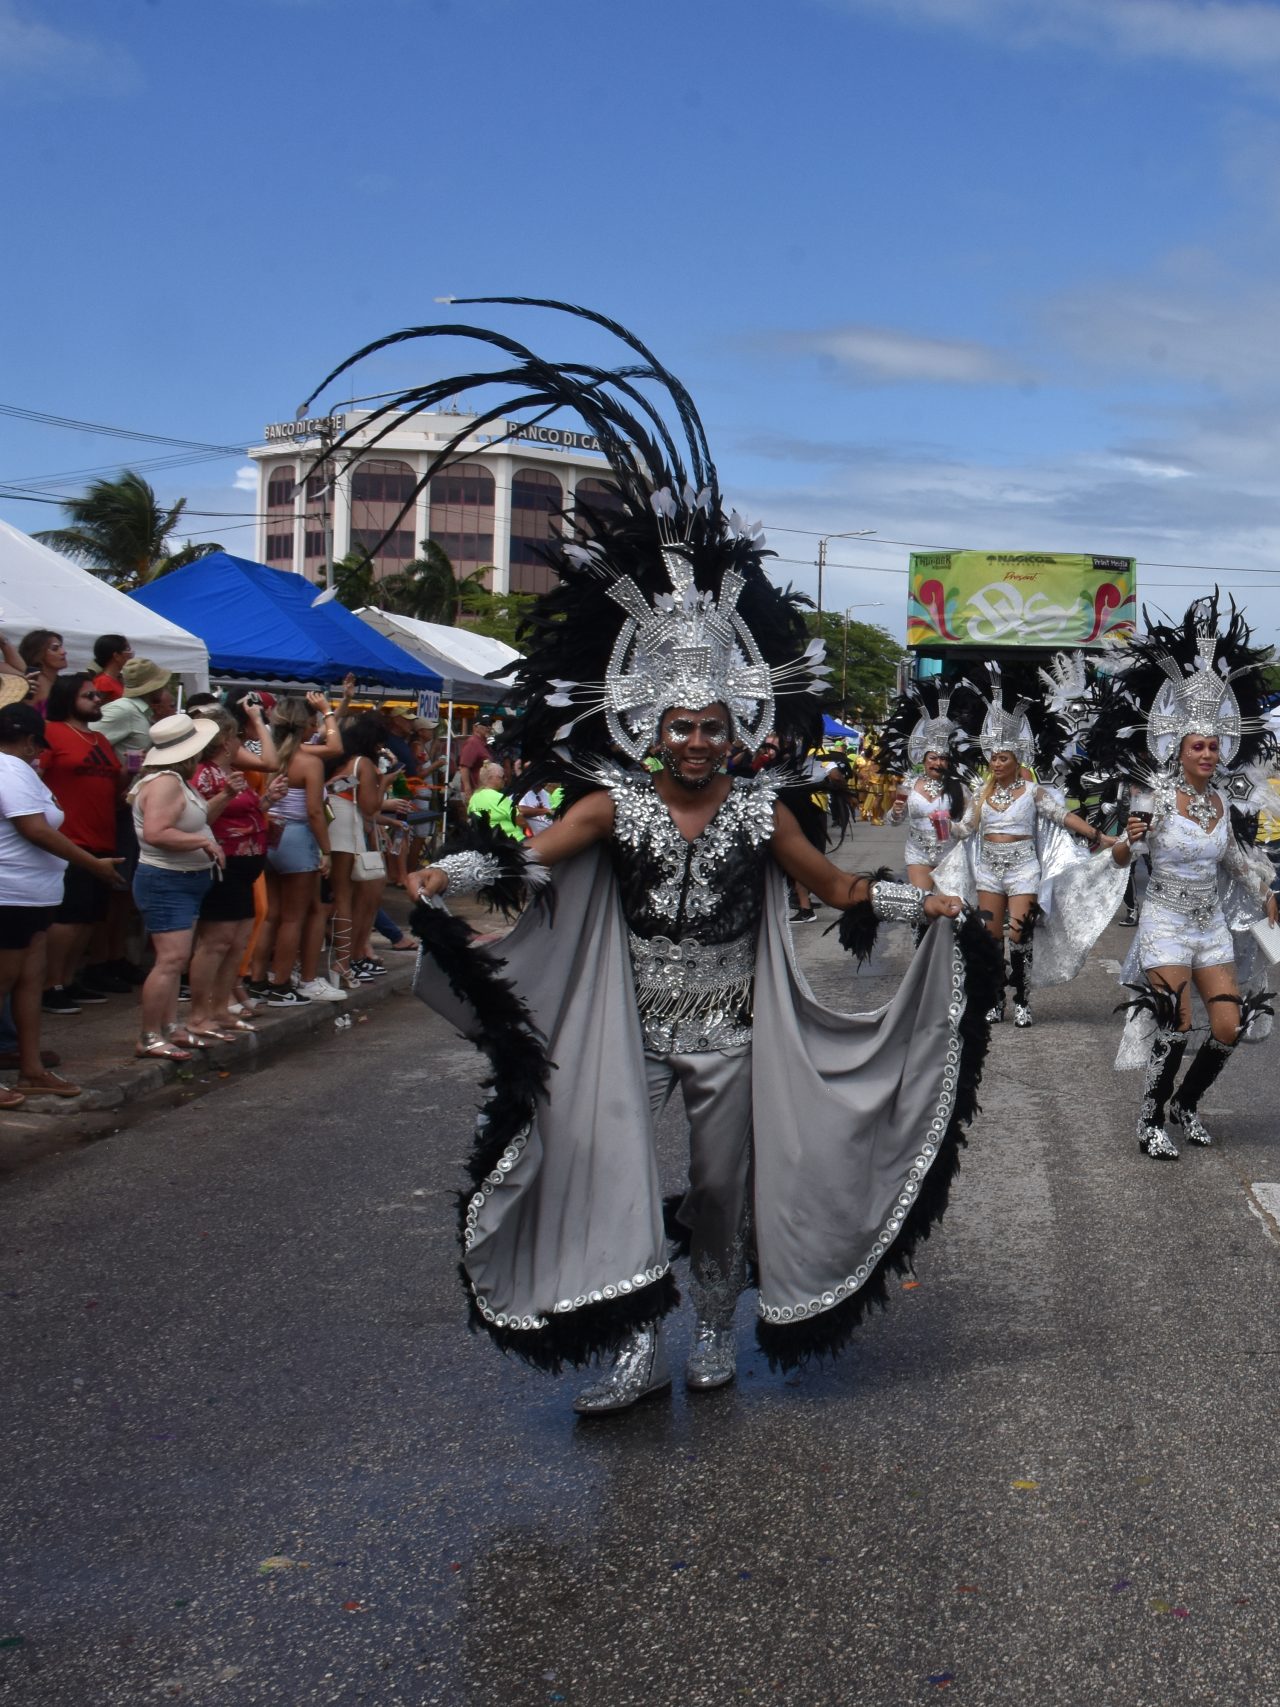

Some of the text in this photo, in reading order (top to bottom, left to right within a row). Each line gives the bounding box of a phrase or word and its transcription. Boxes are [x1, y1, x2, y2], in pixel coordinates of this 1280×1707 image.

[264, 423, 295, 439] BANCO
[296, 421, 306, 434] DI
[563, 432, 577, 447] DI
